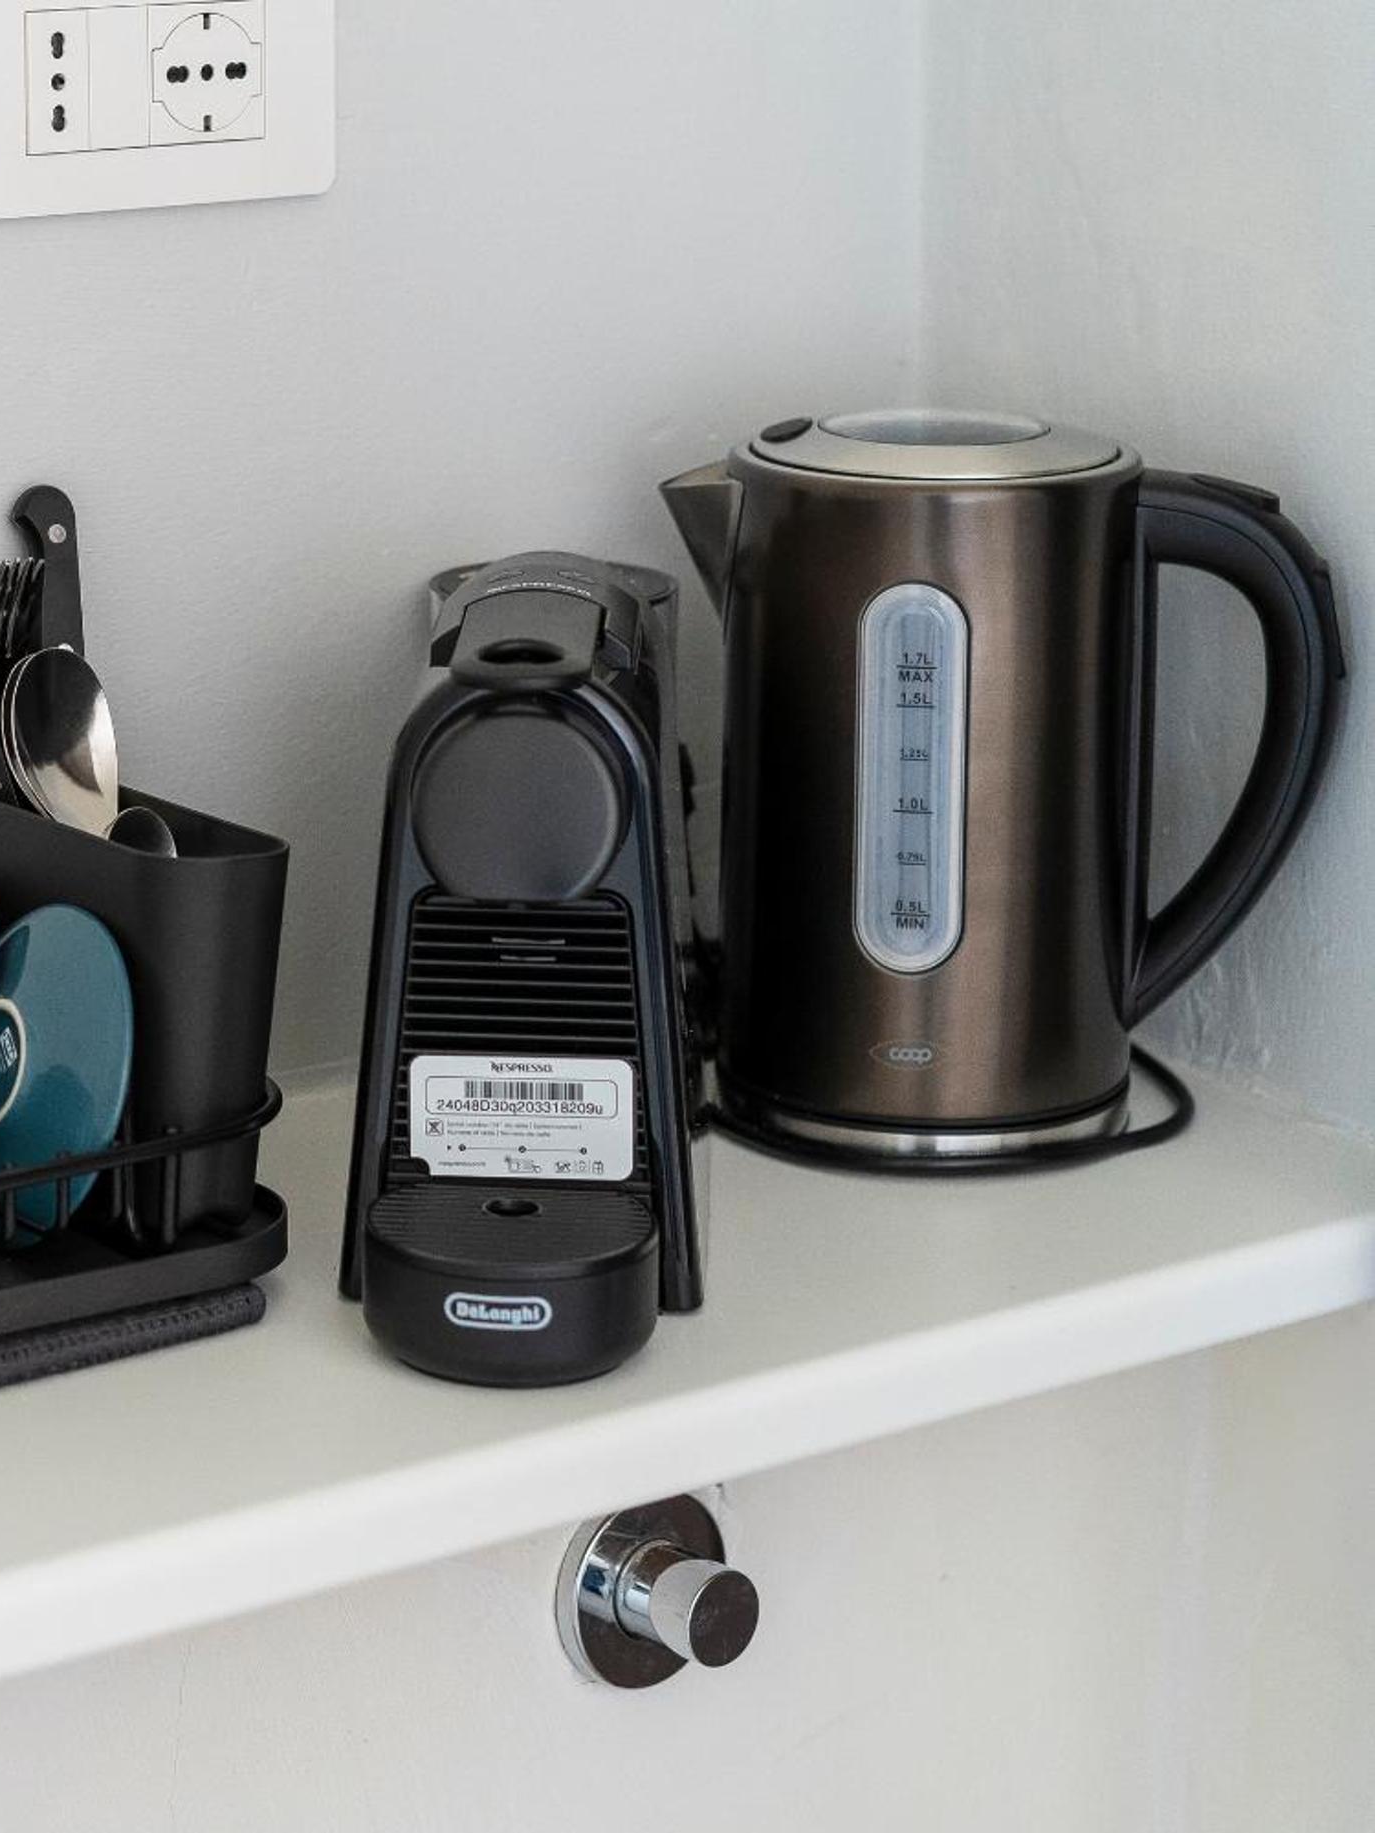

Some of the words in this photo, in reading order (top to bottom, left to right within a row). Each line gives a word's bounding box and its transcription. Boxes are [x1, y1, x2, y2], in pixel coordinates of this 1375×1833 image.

[901, 652, 934, 665] 1.7L
[898, 669, 934, 683] MAX
[900, 692, 933, 705] 1.5L
[898, 797, 929, 811] 1.0L
[895, 899, 926, 914] 0.5L
[896, 916, 925, 930] MIN
